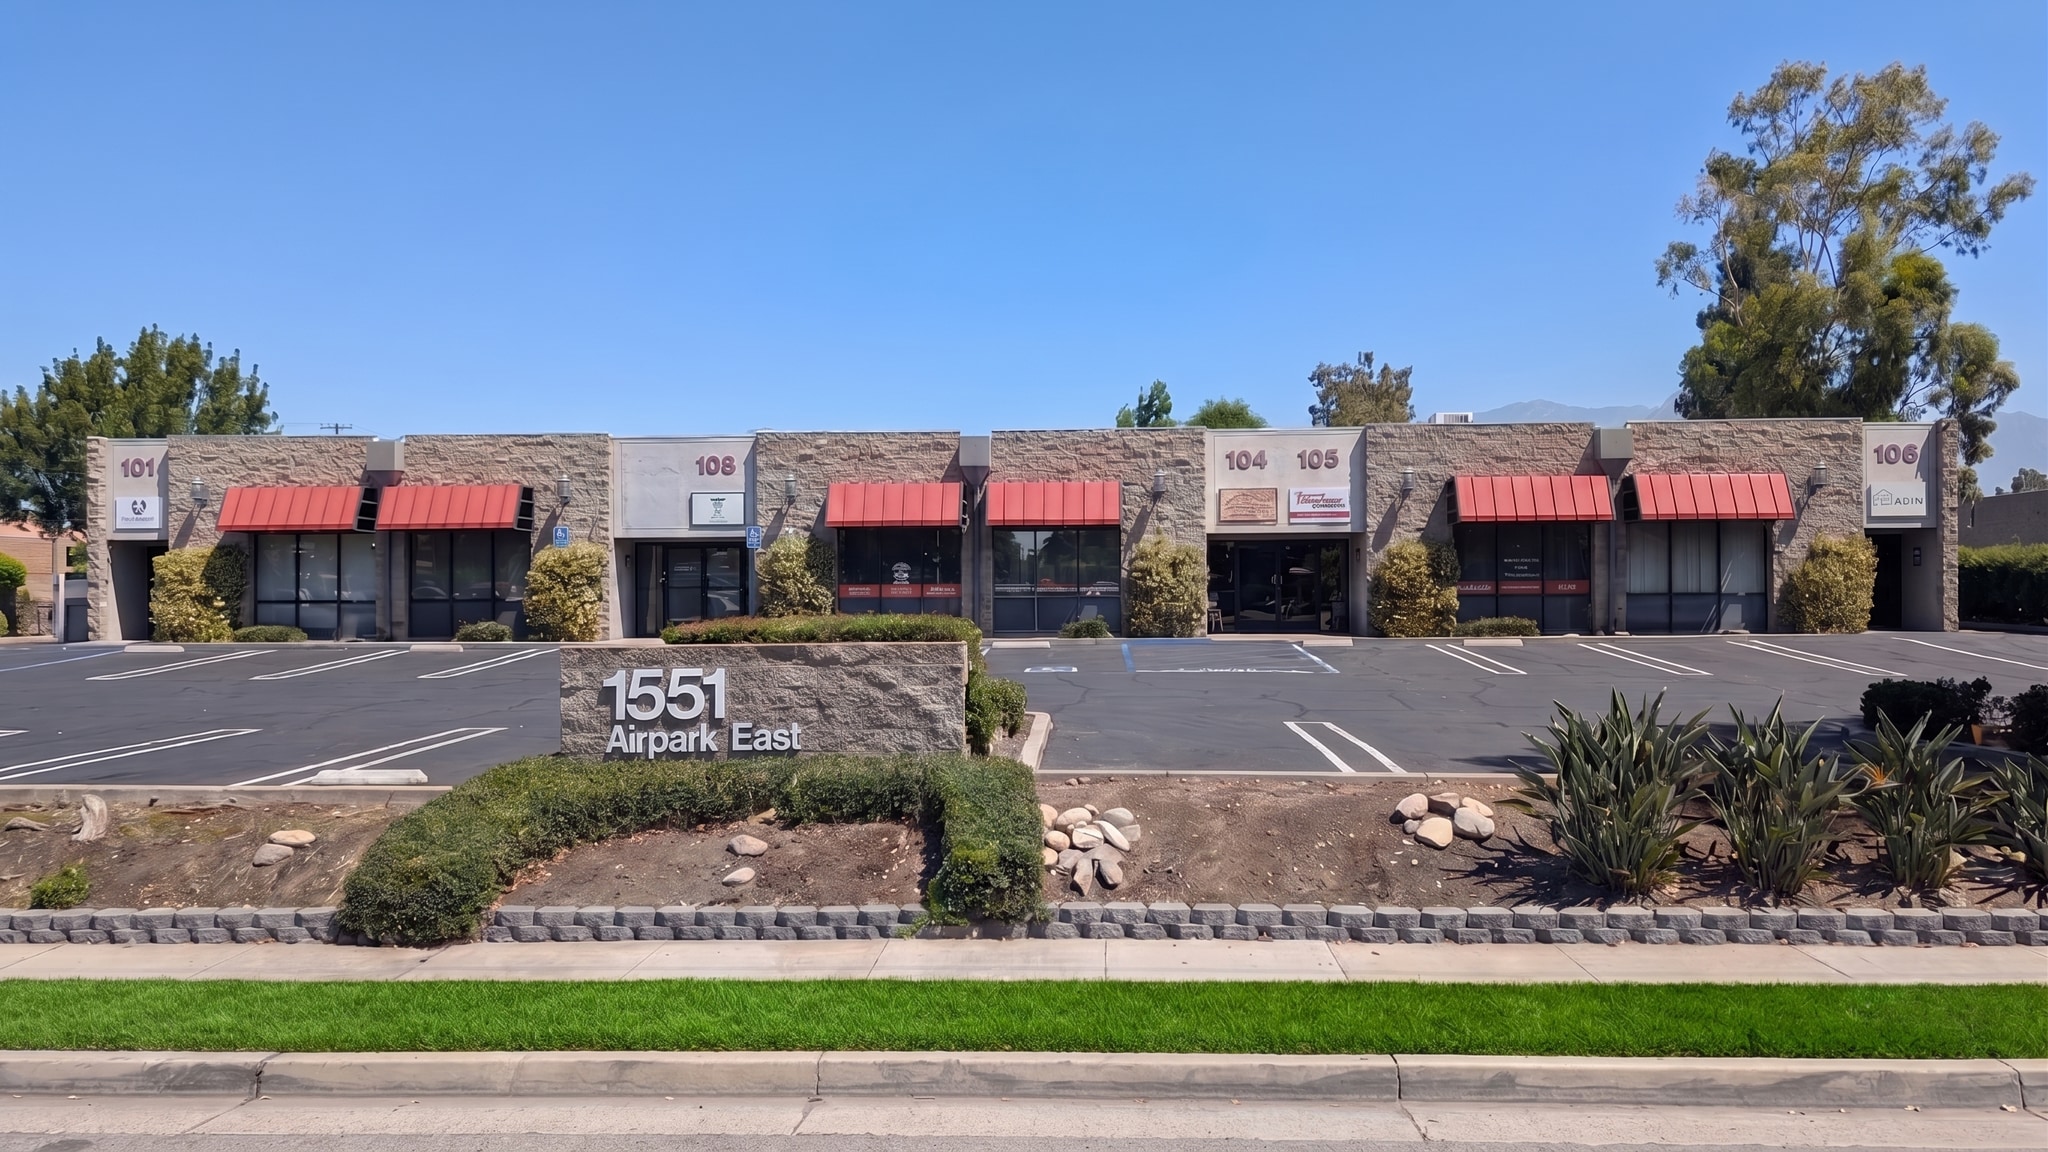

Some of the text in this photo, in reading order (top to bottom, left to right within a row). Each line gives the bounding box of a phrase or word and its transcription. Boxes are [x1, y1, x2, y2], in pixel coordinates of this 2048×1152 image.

[1225, 450, 1267, 470] 104
[1297, 449, 1339, 470] 105
[1873, 444, 1918, 464] 106
[121, 457, 154, 477] 101
[695, 455, 736, 476] 108
[1894, 497, 1923, 505] ADIN
[603, 668, 725, 721] 1551
[606, 722, 802, 759] Airpark East
